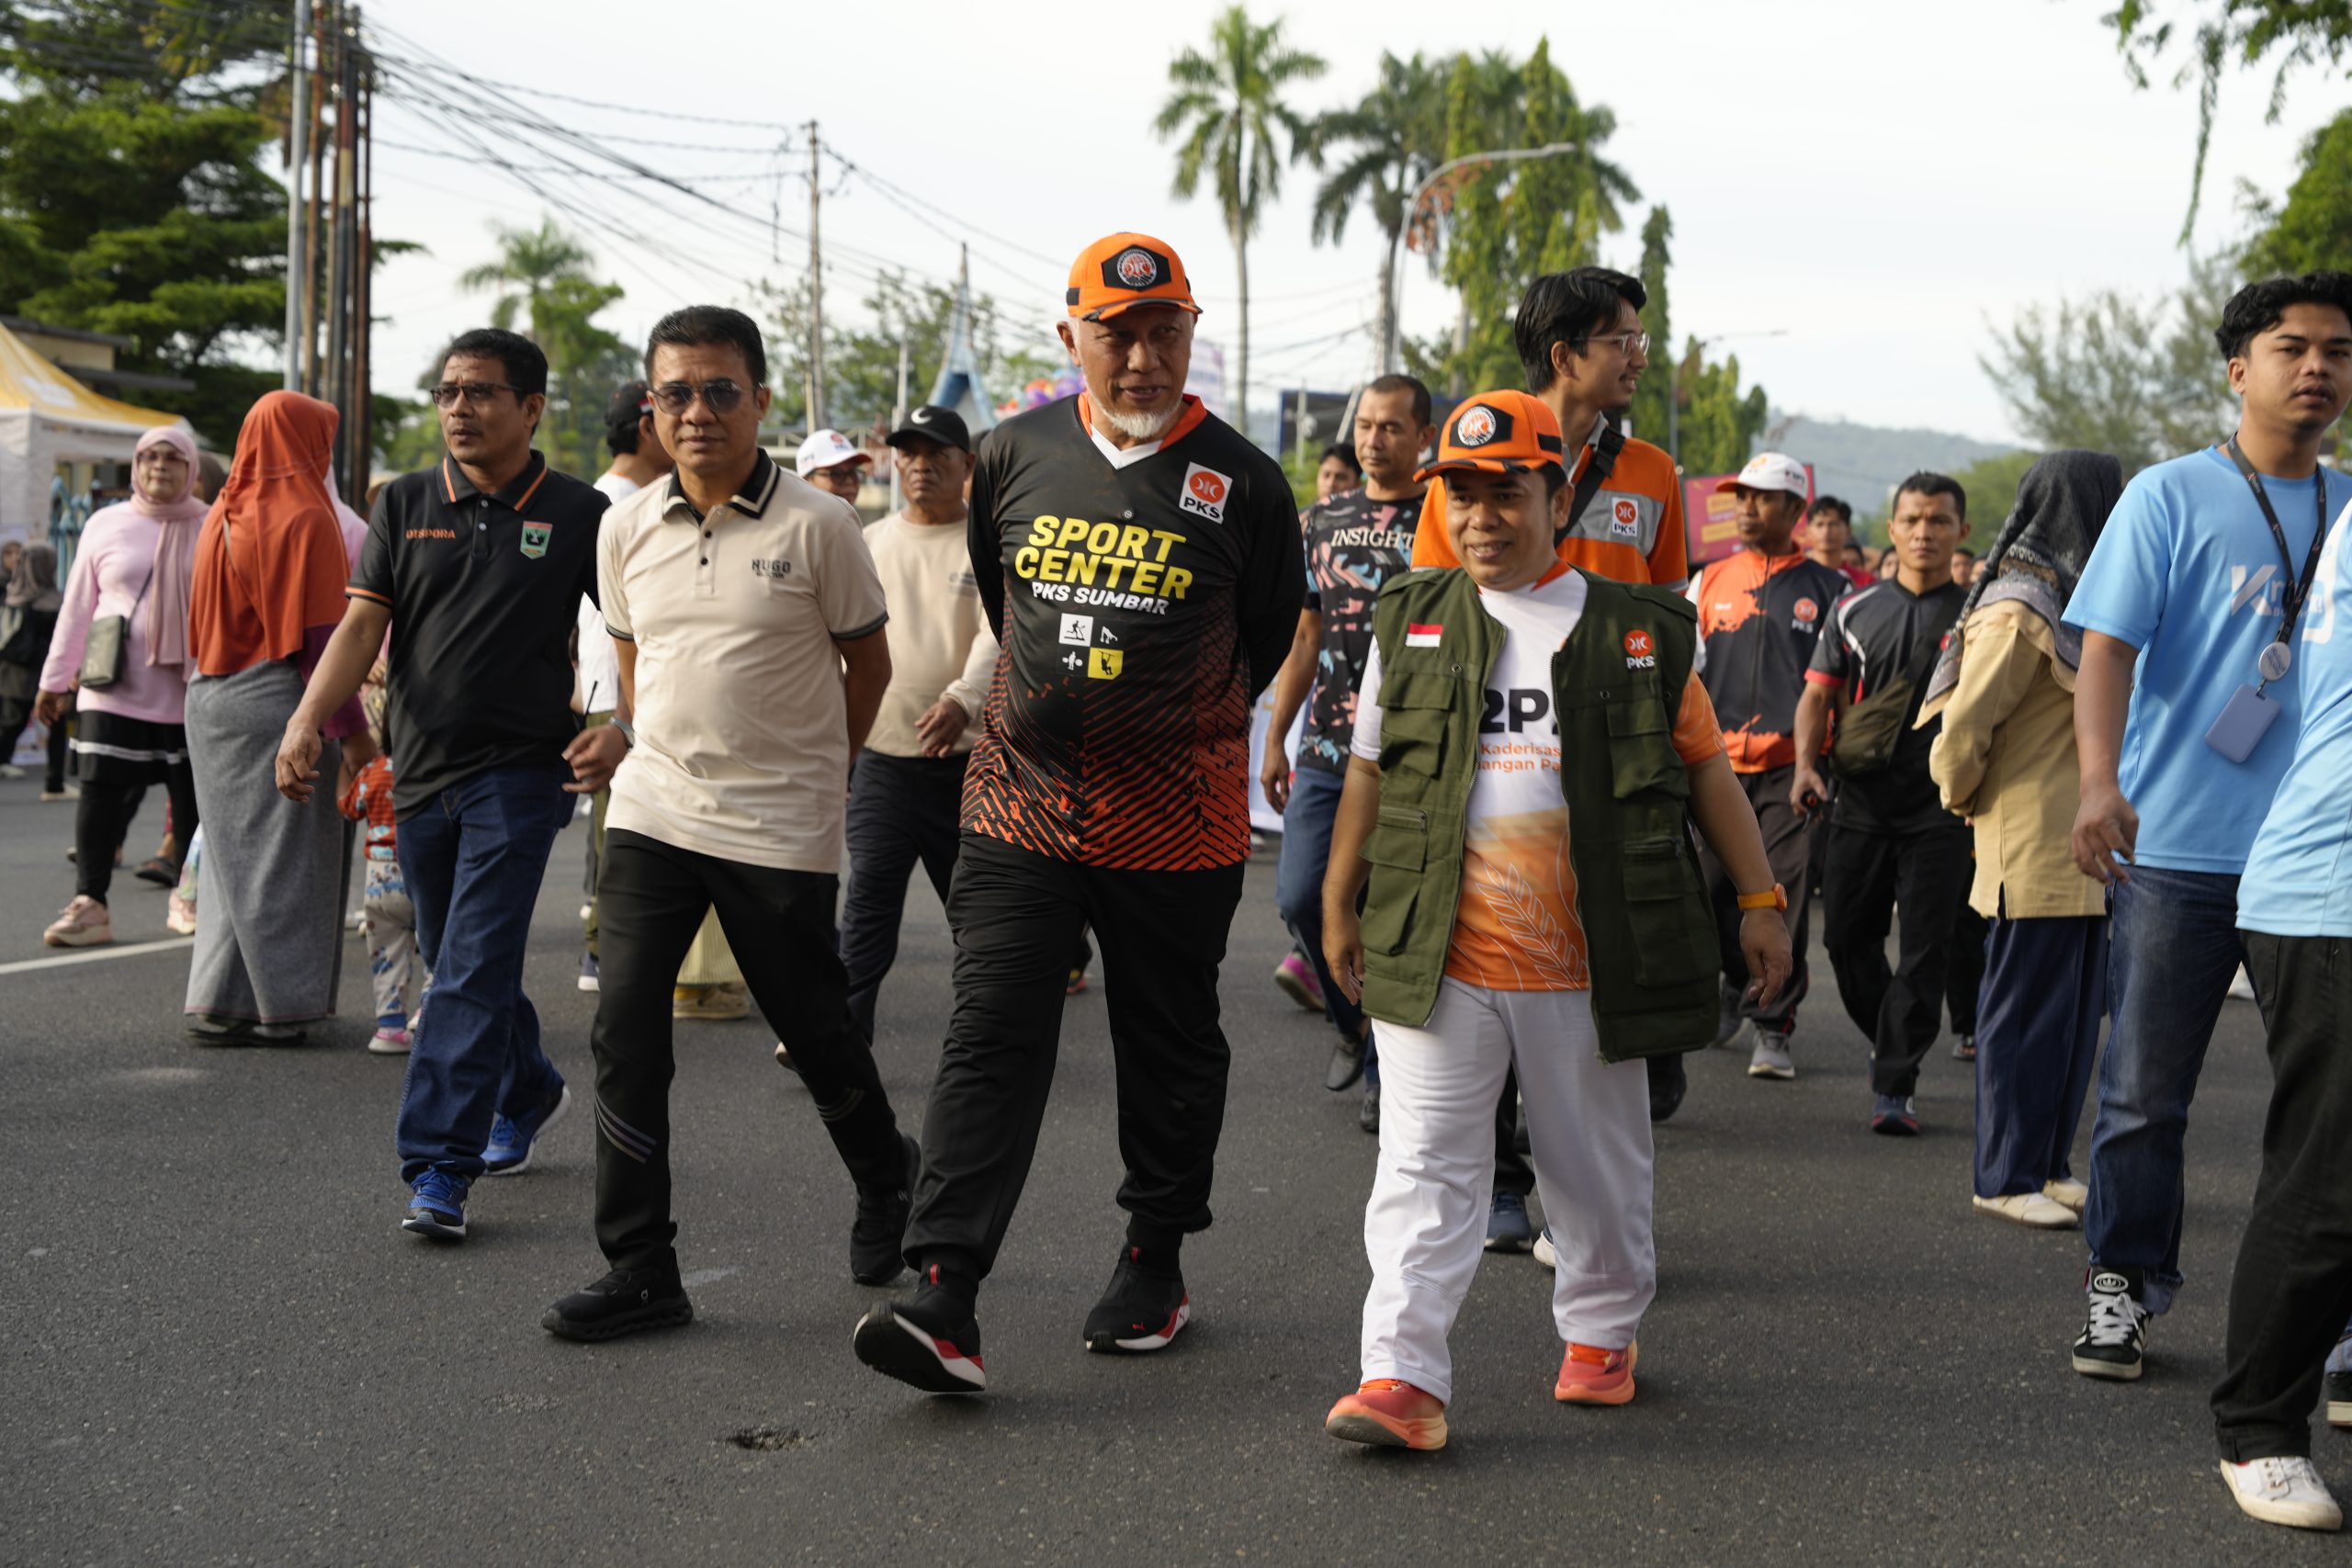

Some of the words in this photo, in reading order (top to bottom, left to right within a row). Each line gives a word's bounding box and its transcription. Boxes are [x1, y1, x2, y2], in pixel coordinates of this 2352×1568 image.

[1183, 497, 1220, 518] PKS
[405, 528, 456, 540] DISPORA
[1028, 514, 1187, 563] SPORT
[1015, 546, 1193, 600] CENTER
[1032, 581, 1069, 602] PKS
[1073, 587, 1170, 615] SUMBAR
[1626, 655, 1656, 669] PKS
